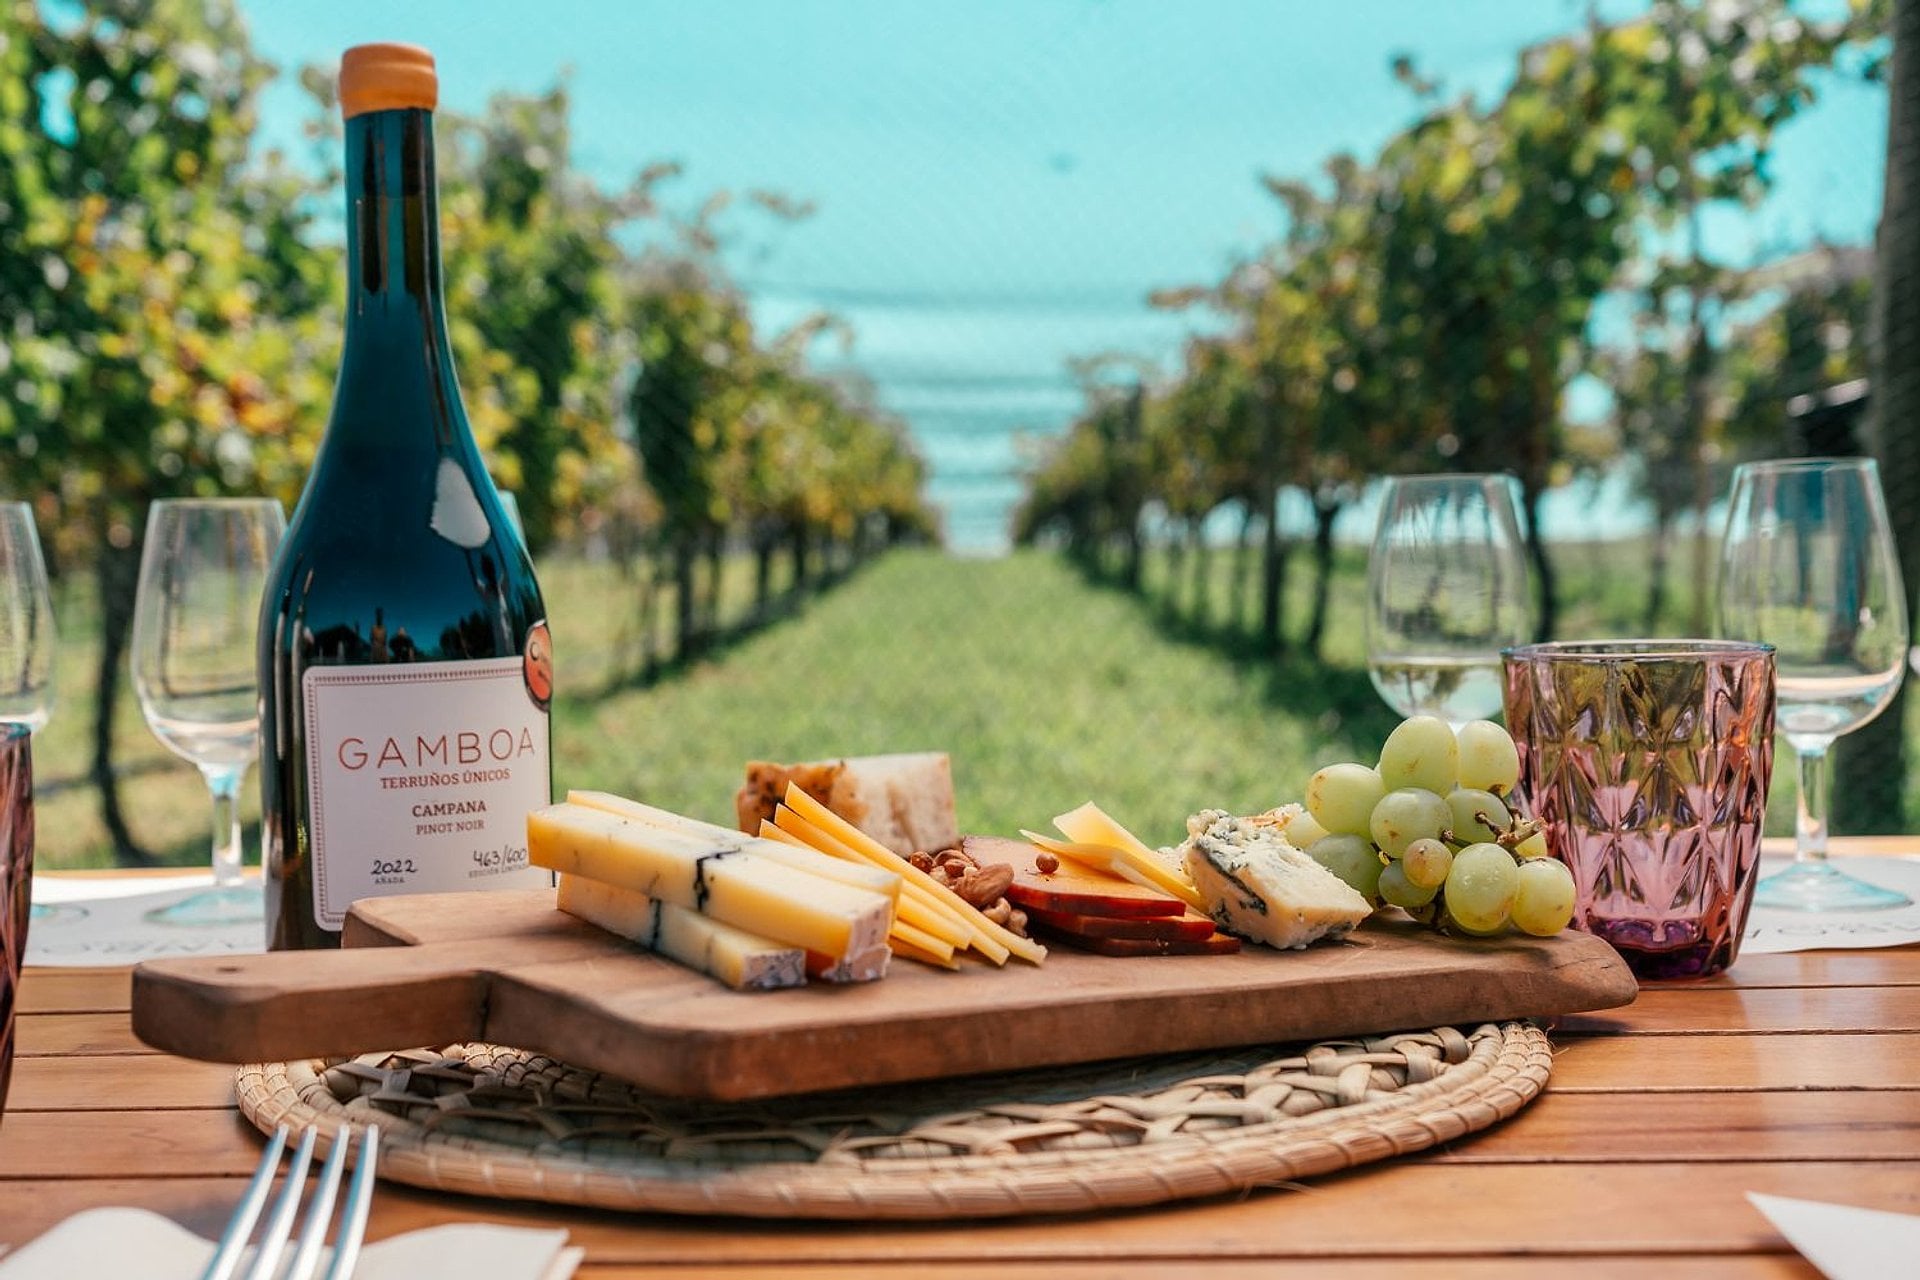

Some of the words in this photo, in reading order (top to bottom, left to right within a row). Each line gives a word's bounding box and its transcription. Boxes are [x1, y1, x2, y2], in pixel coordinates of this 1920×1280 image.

[339, 727, 535, 770] GAMBOA
[381, 773, 460, 789] TERRUÑOS
[463, 768, 511, 784] ÚNICOS
[412, 800, 487, 817] CAMPANA
[416, 823, 453, 835] PINOT
[456, 819, 485, 832] NOIR
[371, 859, 418, 875] 2022
